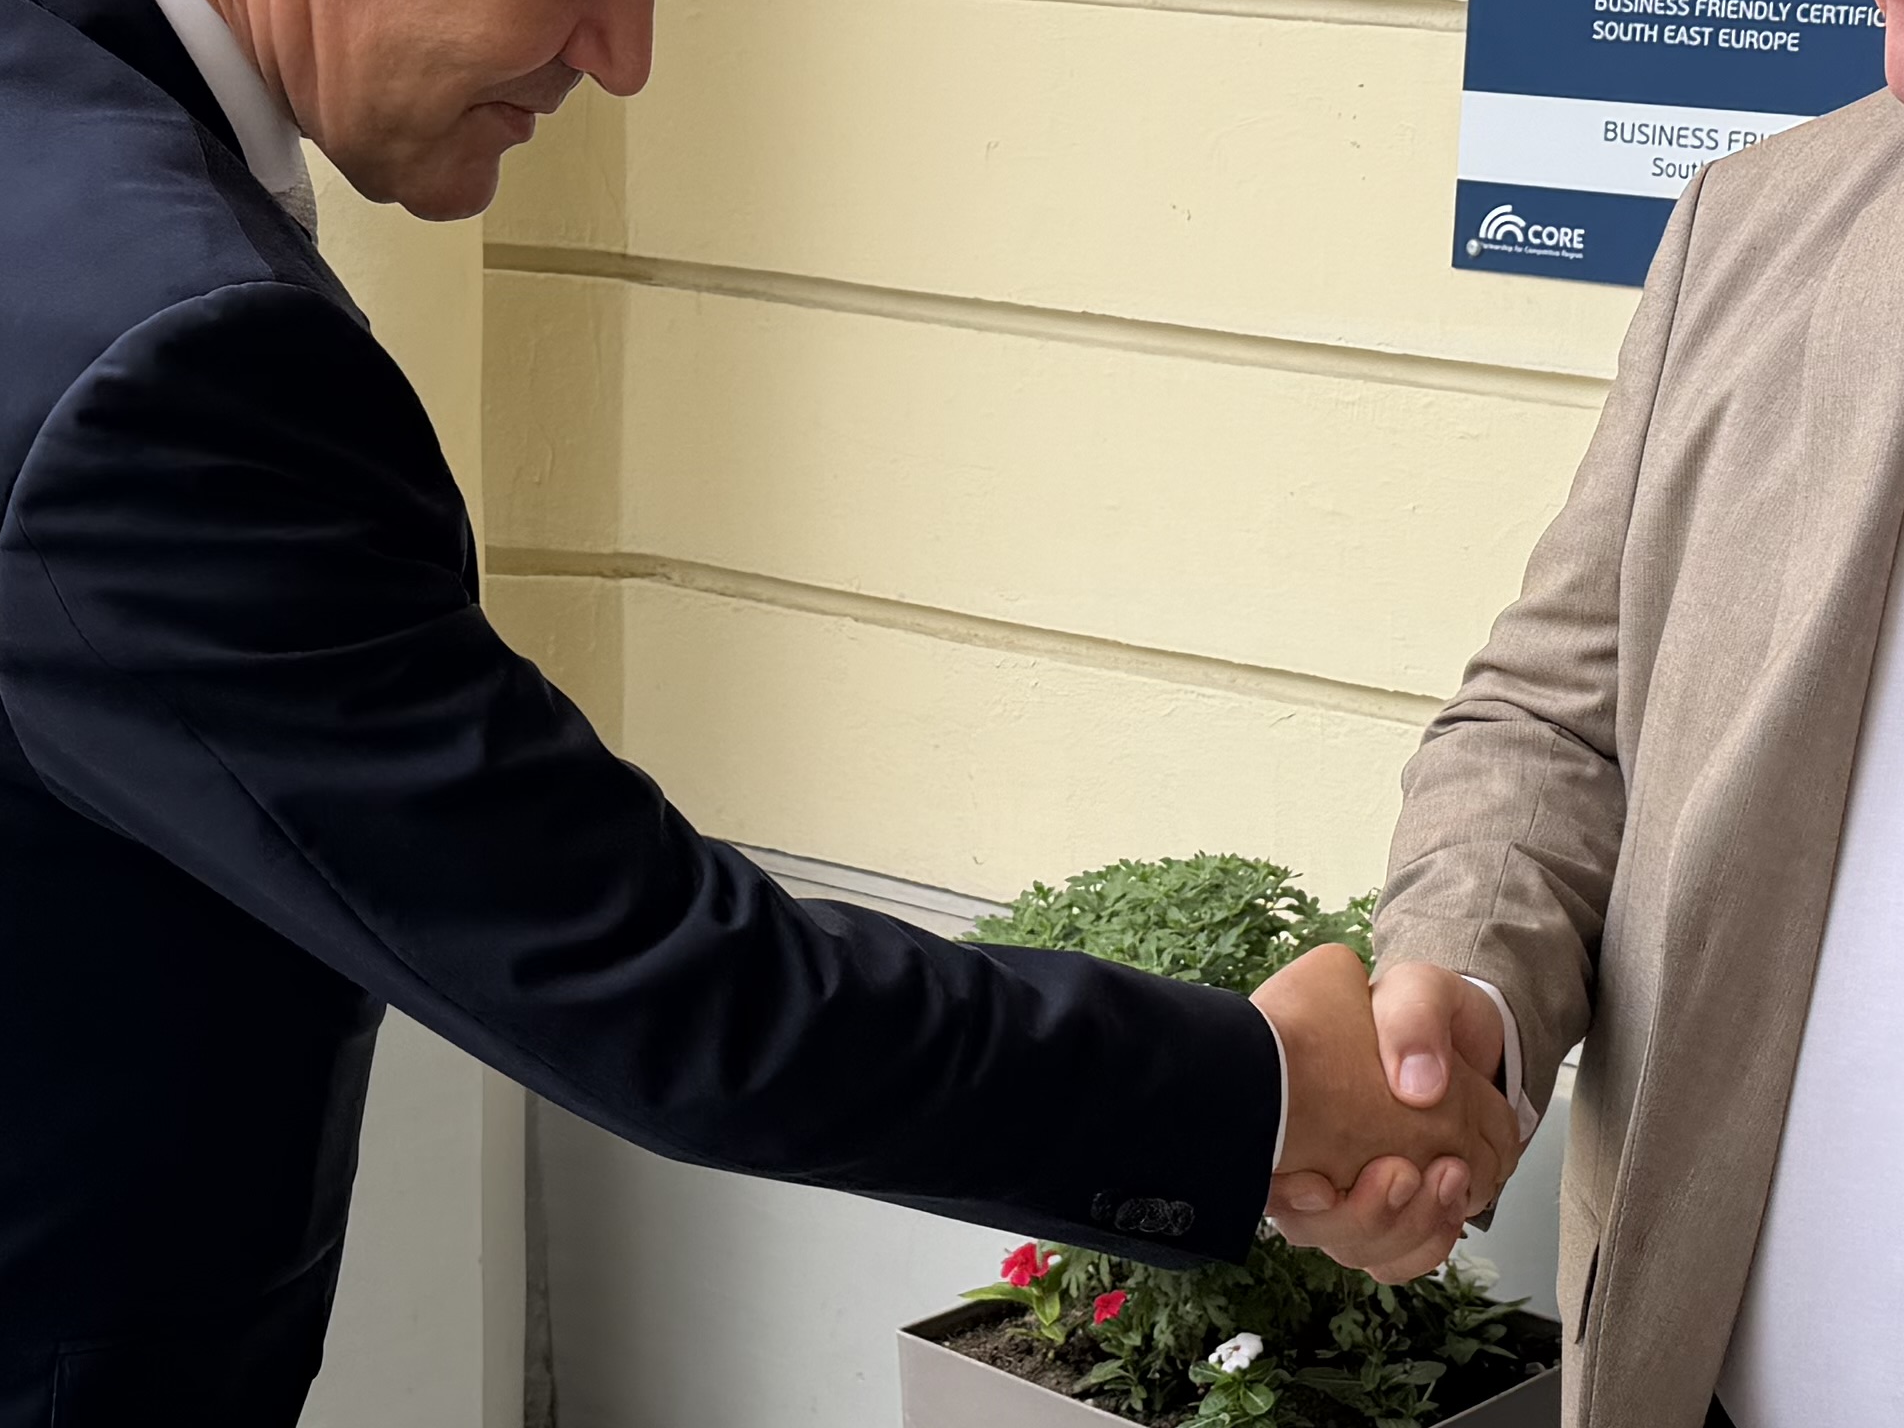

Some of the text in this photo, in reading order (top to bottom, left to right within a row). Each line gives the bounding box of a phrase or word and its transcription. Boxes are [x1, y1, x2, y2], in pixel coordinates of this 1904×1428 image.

[1592, 20, 1800, 51] SOUTH EAST EUROPE
[1603, 120, 1719, 150] BUSINESS
[1527, 224, 1585, 249] CORE
